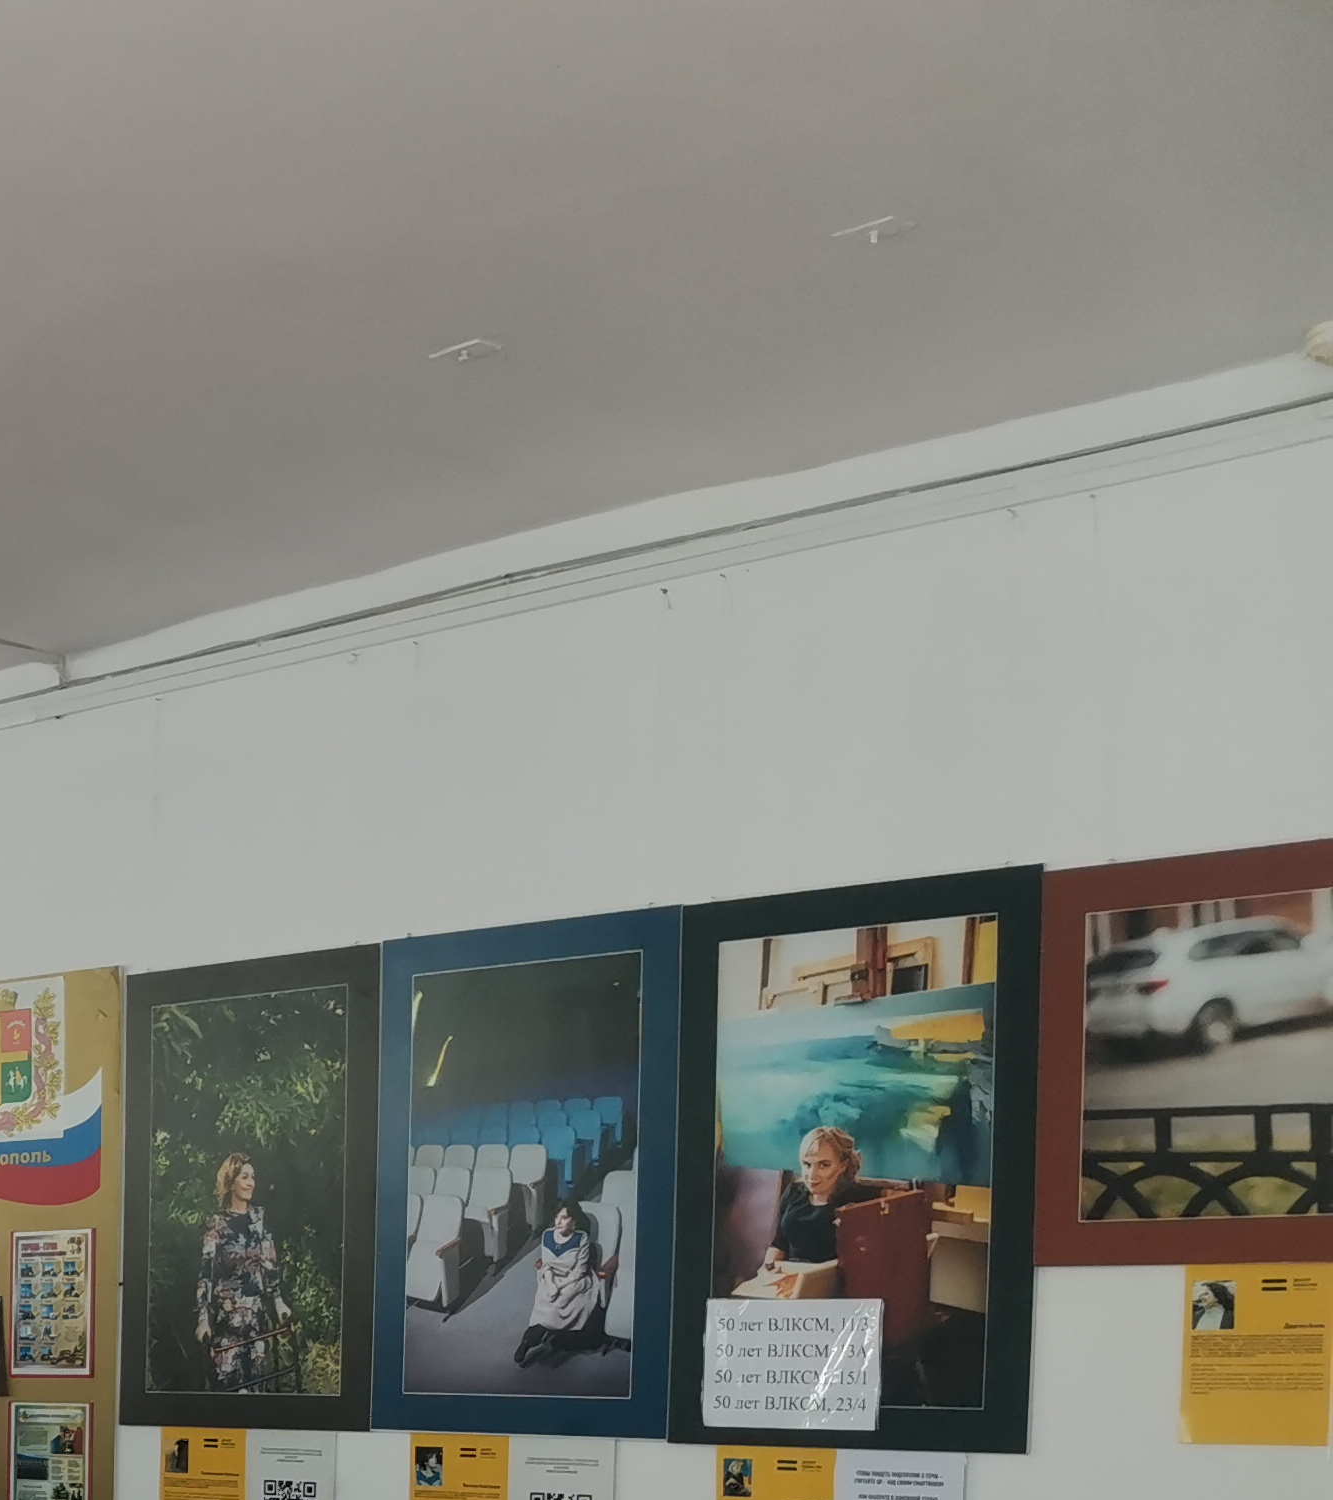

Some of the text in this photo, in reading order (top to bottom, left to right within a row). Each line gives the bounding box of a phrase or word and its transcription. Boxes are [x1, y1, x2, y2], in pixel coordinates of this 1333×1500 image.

[717, 1318, 734, 1331] 50
[739, 1321, 763, 1331] лет
[768, 1317, 834, 1333] ВЛКСМ,
[716, 1344, 733, 1358] 50
[738, 1348, 762, 1358] лет
[715, 1370, 732, 1383] 50
[840, 1370, 867, 1385] 15/1
[713, 1396, 731, 1409] 50
[735, 1400, 760, 1410] лет
[836, 1398, 866, 1411] 23/4
